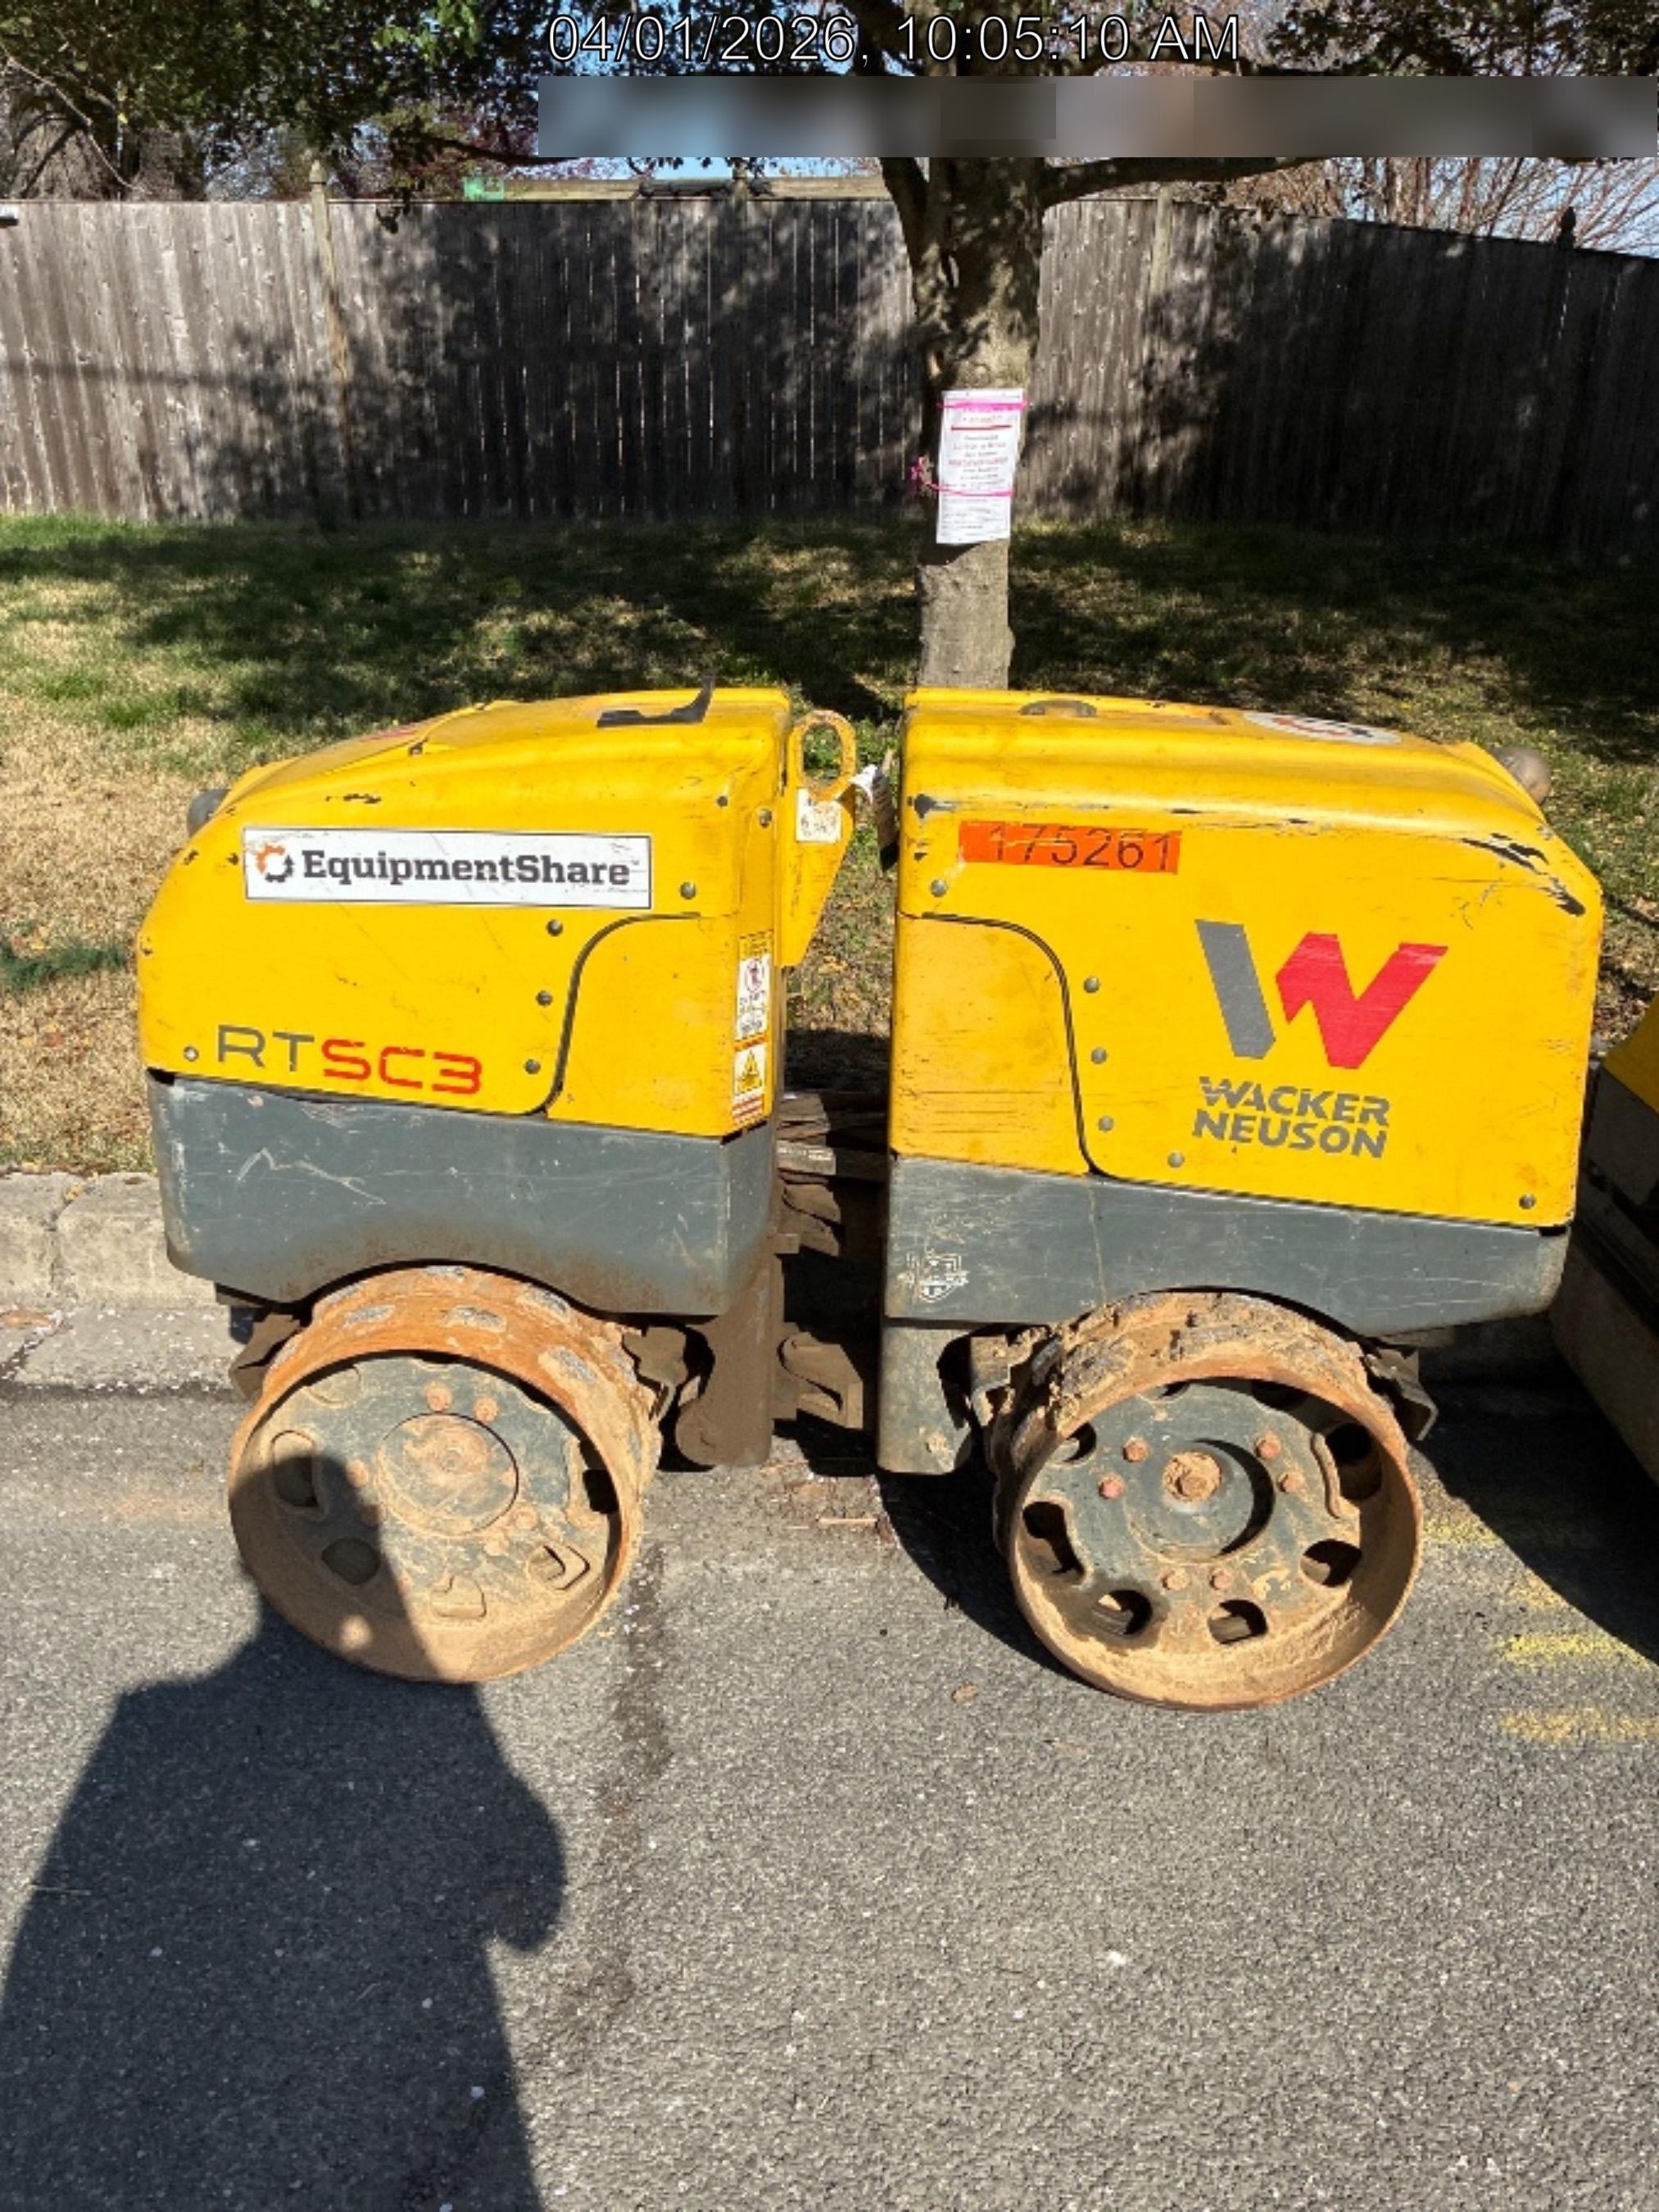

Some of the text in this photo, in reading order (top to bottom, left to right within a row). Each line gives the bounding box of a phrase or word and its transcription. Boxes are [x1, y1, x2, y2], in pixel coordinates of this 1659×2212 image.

[301, 850, 631, 886] EquipmentShare
[990, 823, 1170, 871] 175261
[1199, 1076, 1390, 1127] WACKER
[1192, 1108, 1388, 1158] NEUSON
